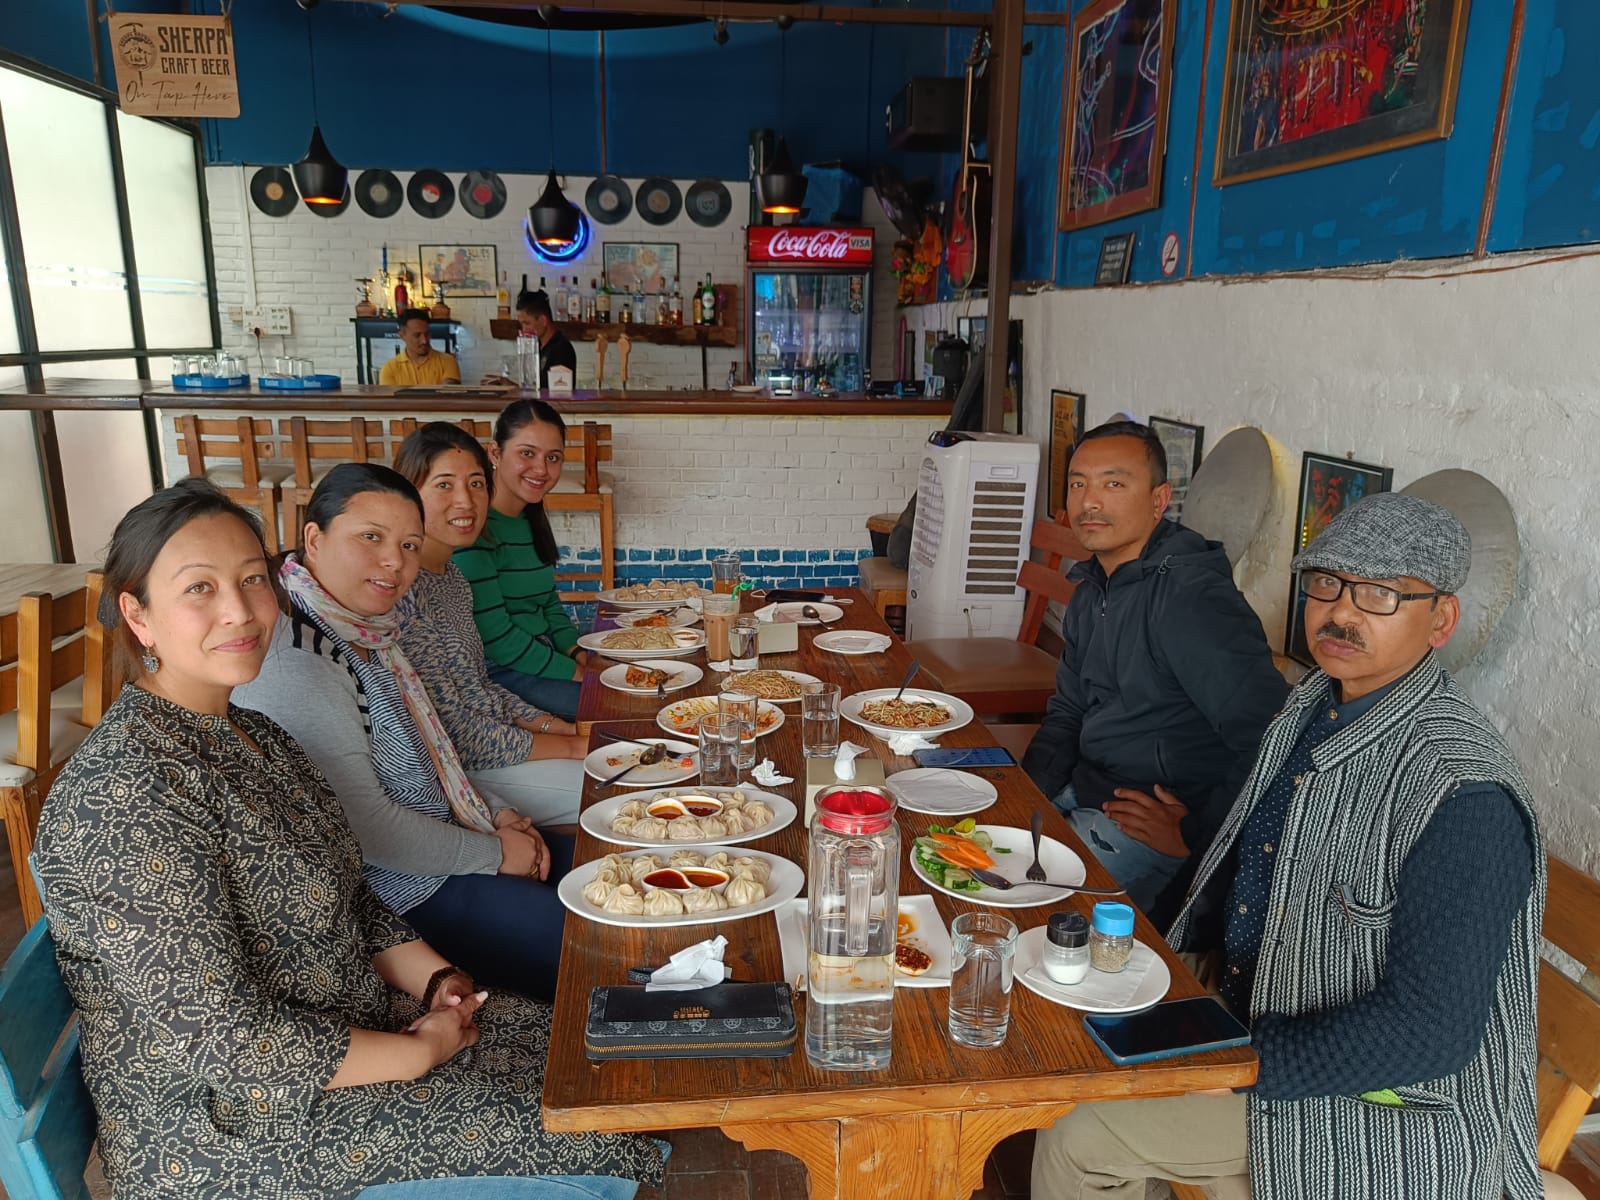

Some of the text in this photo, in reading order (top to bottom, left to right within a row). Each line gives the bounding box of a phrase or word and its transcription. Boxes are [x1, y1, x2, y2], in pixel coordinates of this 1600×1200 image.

[158, 27, 228, 55] SHERPA
[161, 57, 230, 75] CRAFT BEER
[126, 80, 232, 111] On Tap Here
[768, 230, 851, 258] Coca-Cola
[851, 239, 870, 248] VISA
